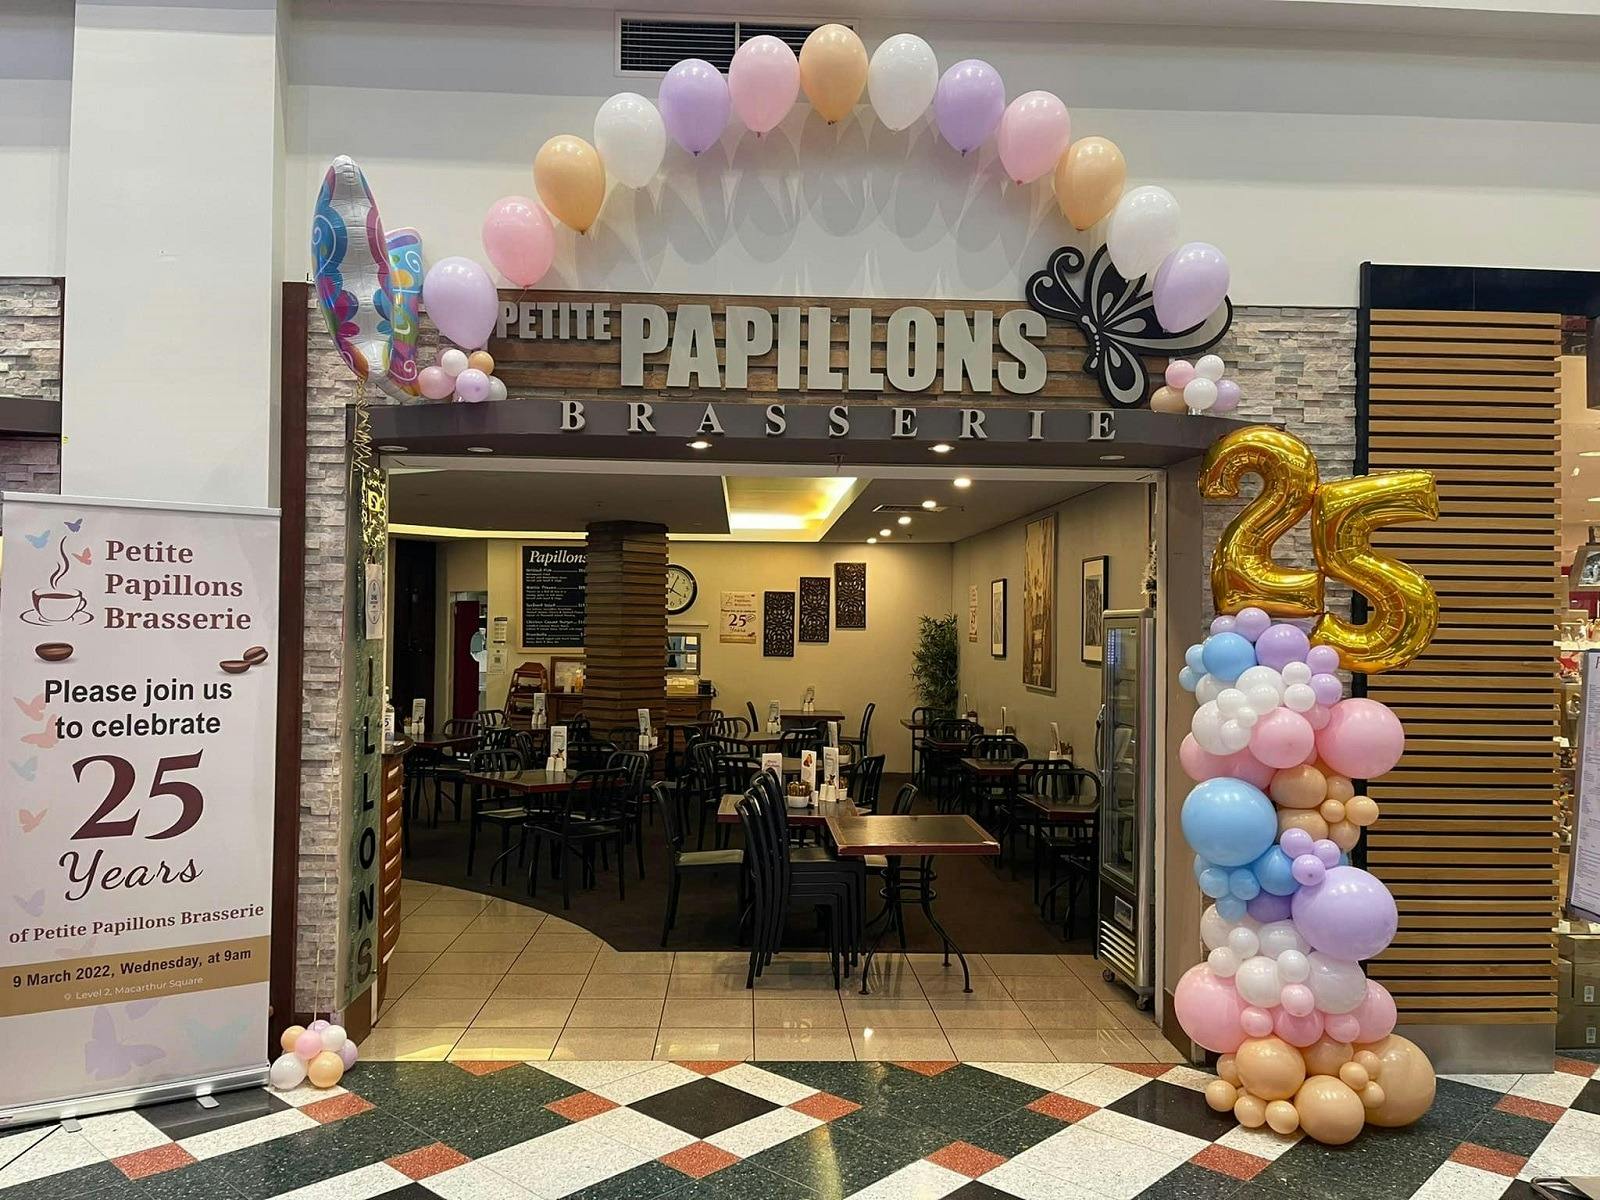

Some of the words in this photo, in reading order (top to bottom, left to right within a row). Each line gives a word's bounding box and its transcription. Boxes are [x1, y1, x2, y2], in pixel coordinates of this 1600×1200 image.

[497, 301, 612, 340] PETITE
[620, 303, 1047, 395] PAPILLONS
[559, 400, 1117, 441] BRASSERIE
[105, 539, 194, 563] Petite
[1197, 424, 1440, 675] 25
[104, 573, 243, 601] Papillons
[103, 606, 251, 630] Brasserie
[728, 613, 747, 628] 25
[44, 679, 137, 703] Please
[143, 678, 194, 707] join
[203, 682, 233, 701] us
[55, 715, 83, 739] to
[91, 712, 221, 737] celebrate
[70, 749, 204, 840] 25
[58, 849, 203, 901] Years
[9, 927, 33, 944] of
[33, 923, 87, 942] Petite
[92, 914, 176, 936] Papillons
[180, 904, 264, 925] Brasserie
[13, 975, 22, 988] 9
[27, 969, 71, 987] March
[75, 964, 115, 982] 2022,
[120, 955, 202, 977] Wednesday,
[207, 952, 221, 966] at
[224, 949, 251, 962] 9am
[76, 989, 102, 1000] Level
[115, 982, 167, 995] Macarthur
[169, 976, 204, 989] Square
